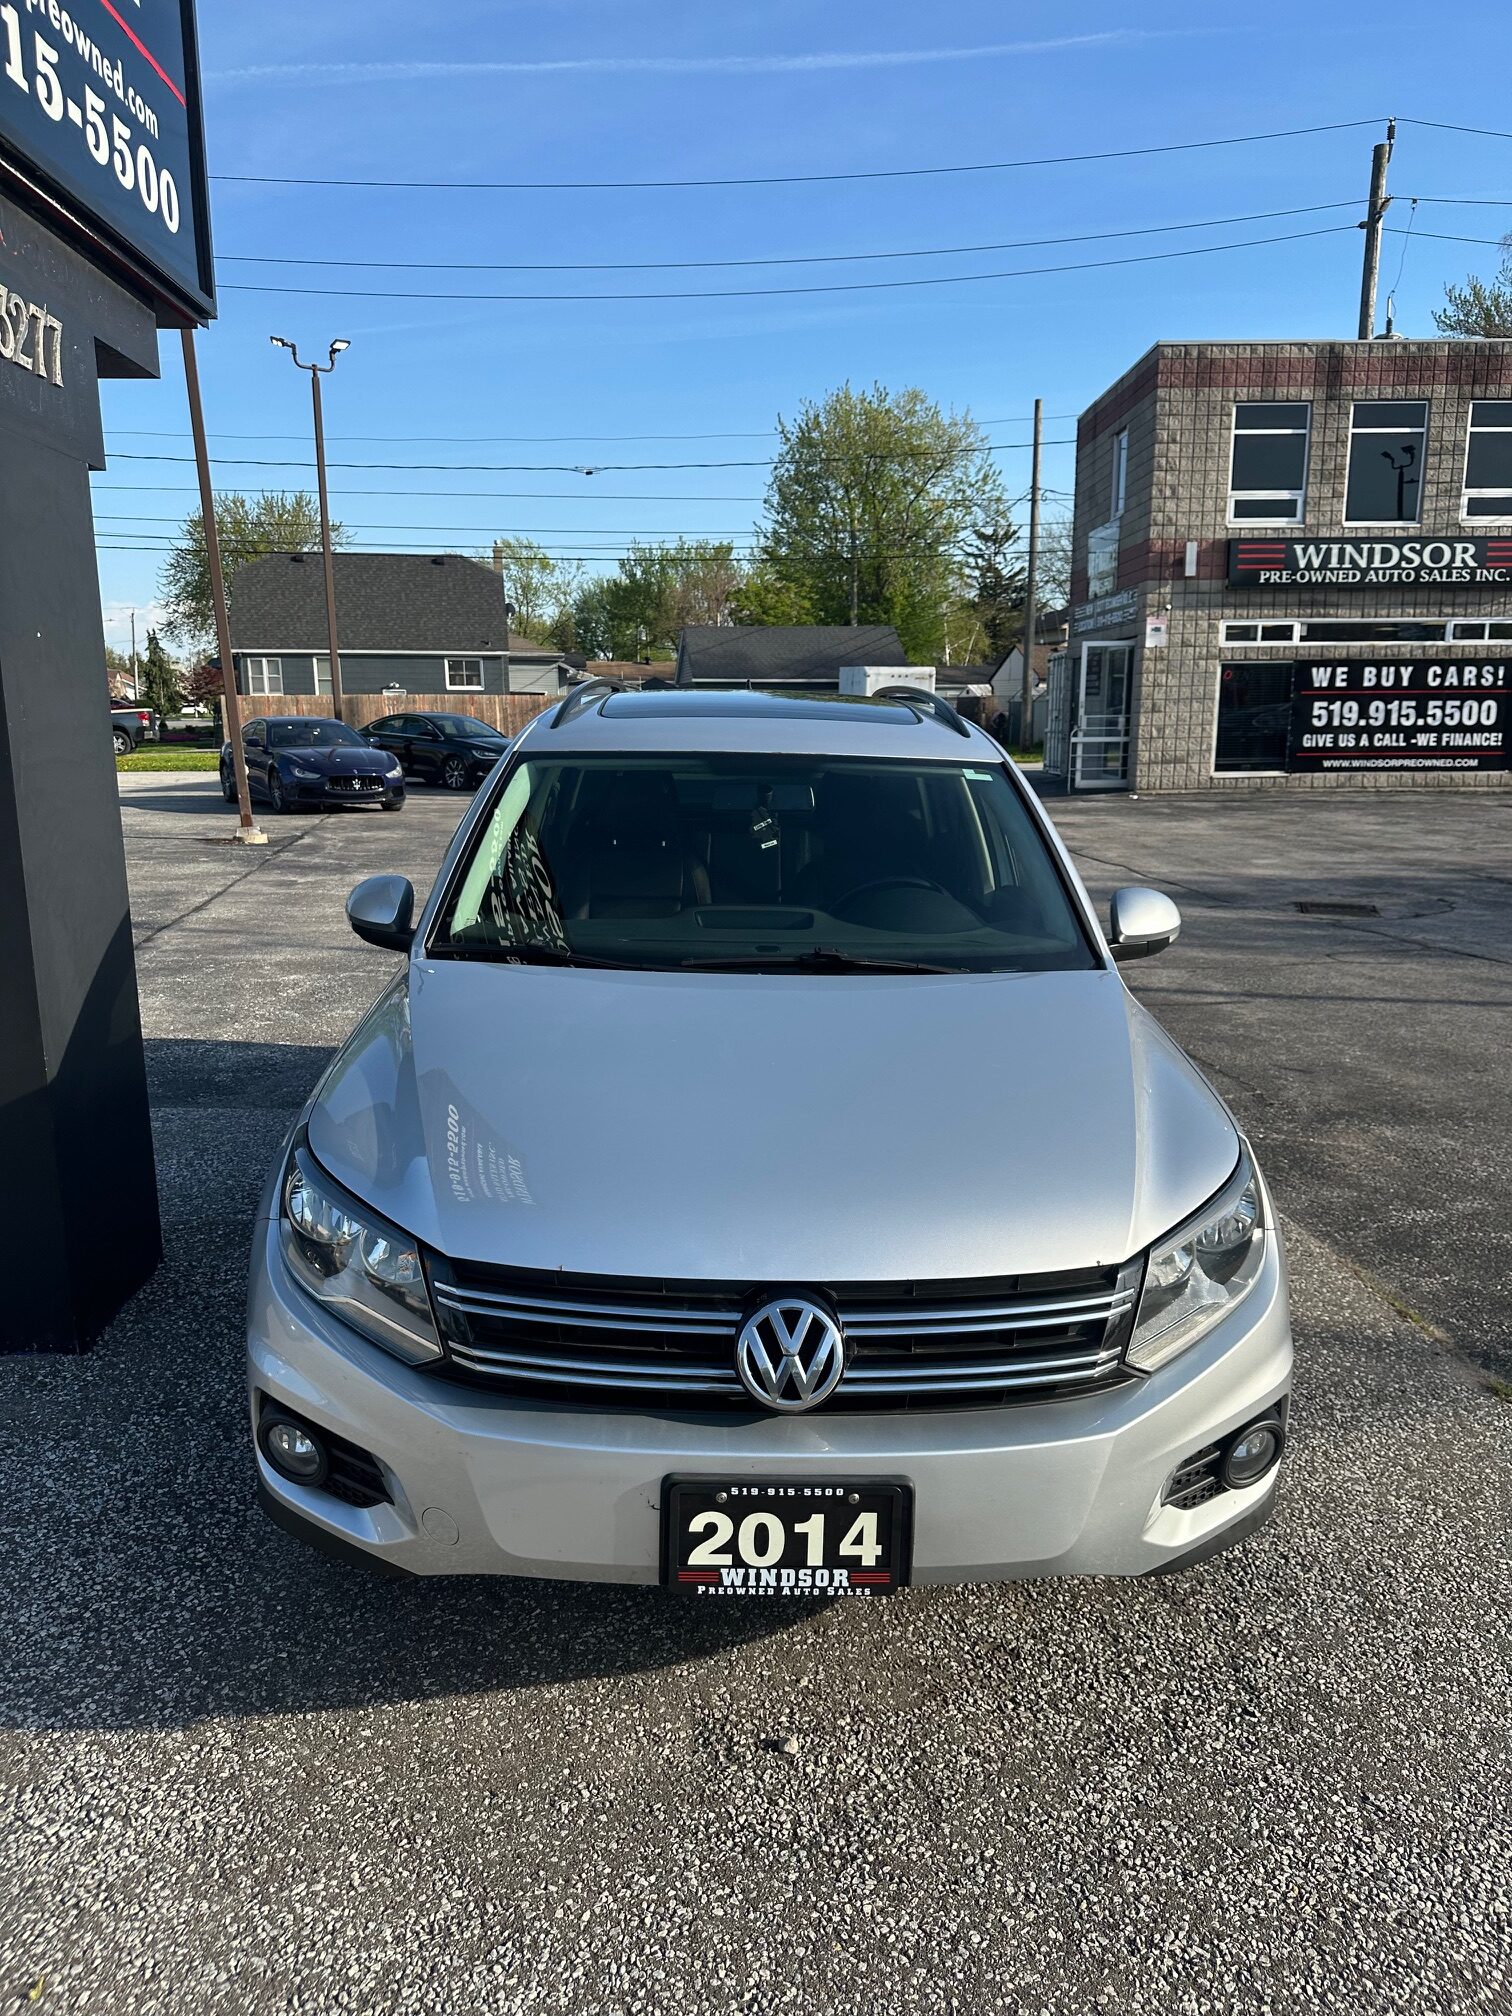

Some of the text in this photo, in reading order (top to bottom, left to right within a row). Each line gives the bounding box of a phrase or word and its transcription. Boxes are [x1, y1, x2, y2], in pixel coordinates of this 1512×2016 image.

[1294, 542, 1478, 569] WINDSOR
[1259, 569, 1511, 584] PRE-OWNED AUTO SALES INC.
[1311, 665, 1506, 688] WE BUY CARS!
[1311, 700, 1498, 727] 519.915.5500
[1302, 734, 1334, 748] GIVE
[1338, 734, 1356, 748] US
[1359, 734, 1369, 747] A
[1373, 733, 1407, 747] CALL
[1441, 732, 1503, 747] FINANCE!
[1323, 758, 1479, 768] WWW.WINDSORPREOWNED.COM
[731, 1487, 844, 1497] 519-915-5500
[687, 1511, 883, 1567] 2014
[720, 1568, 850, 1587] WINDSOR
[697, 1585, 871, 1596] PREOWNED AUTO SALES
